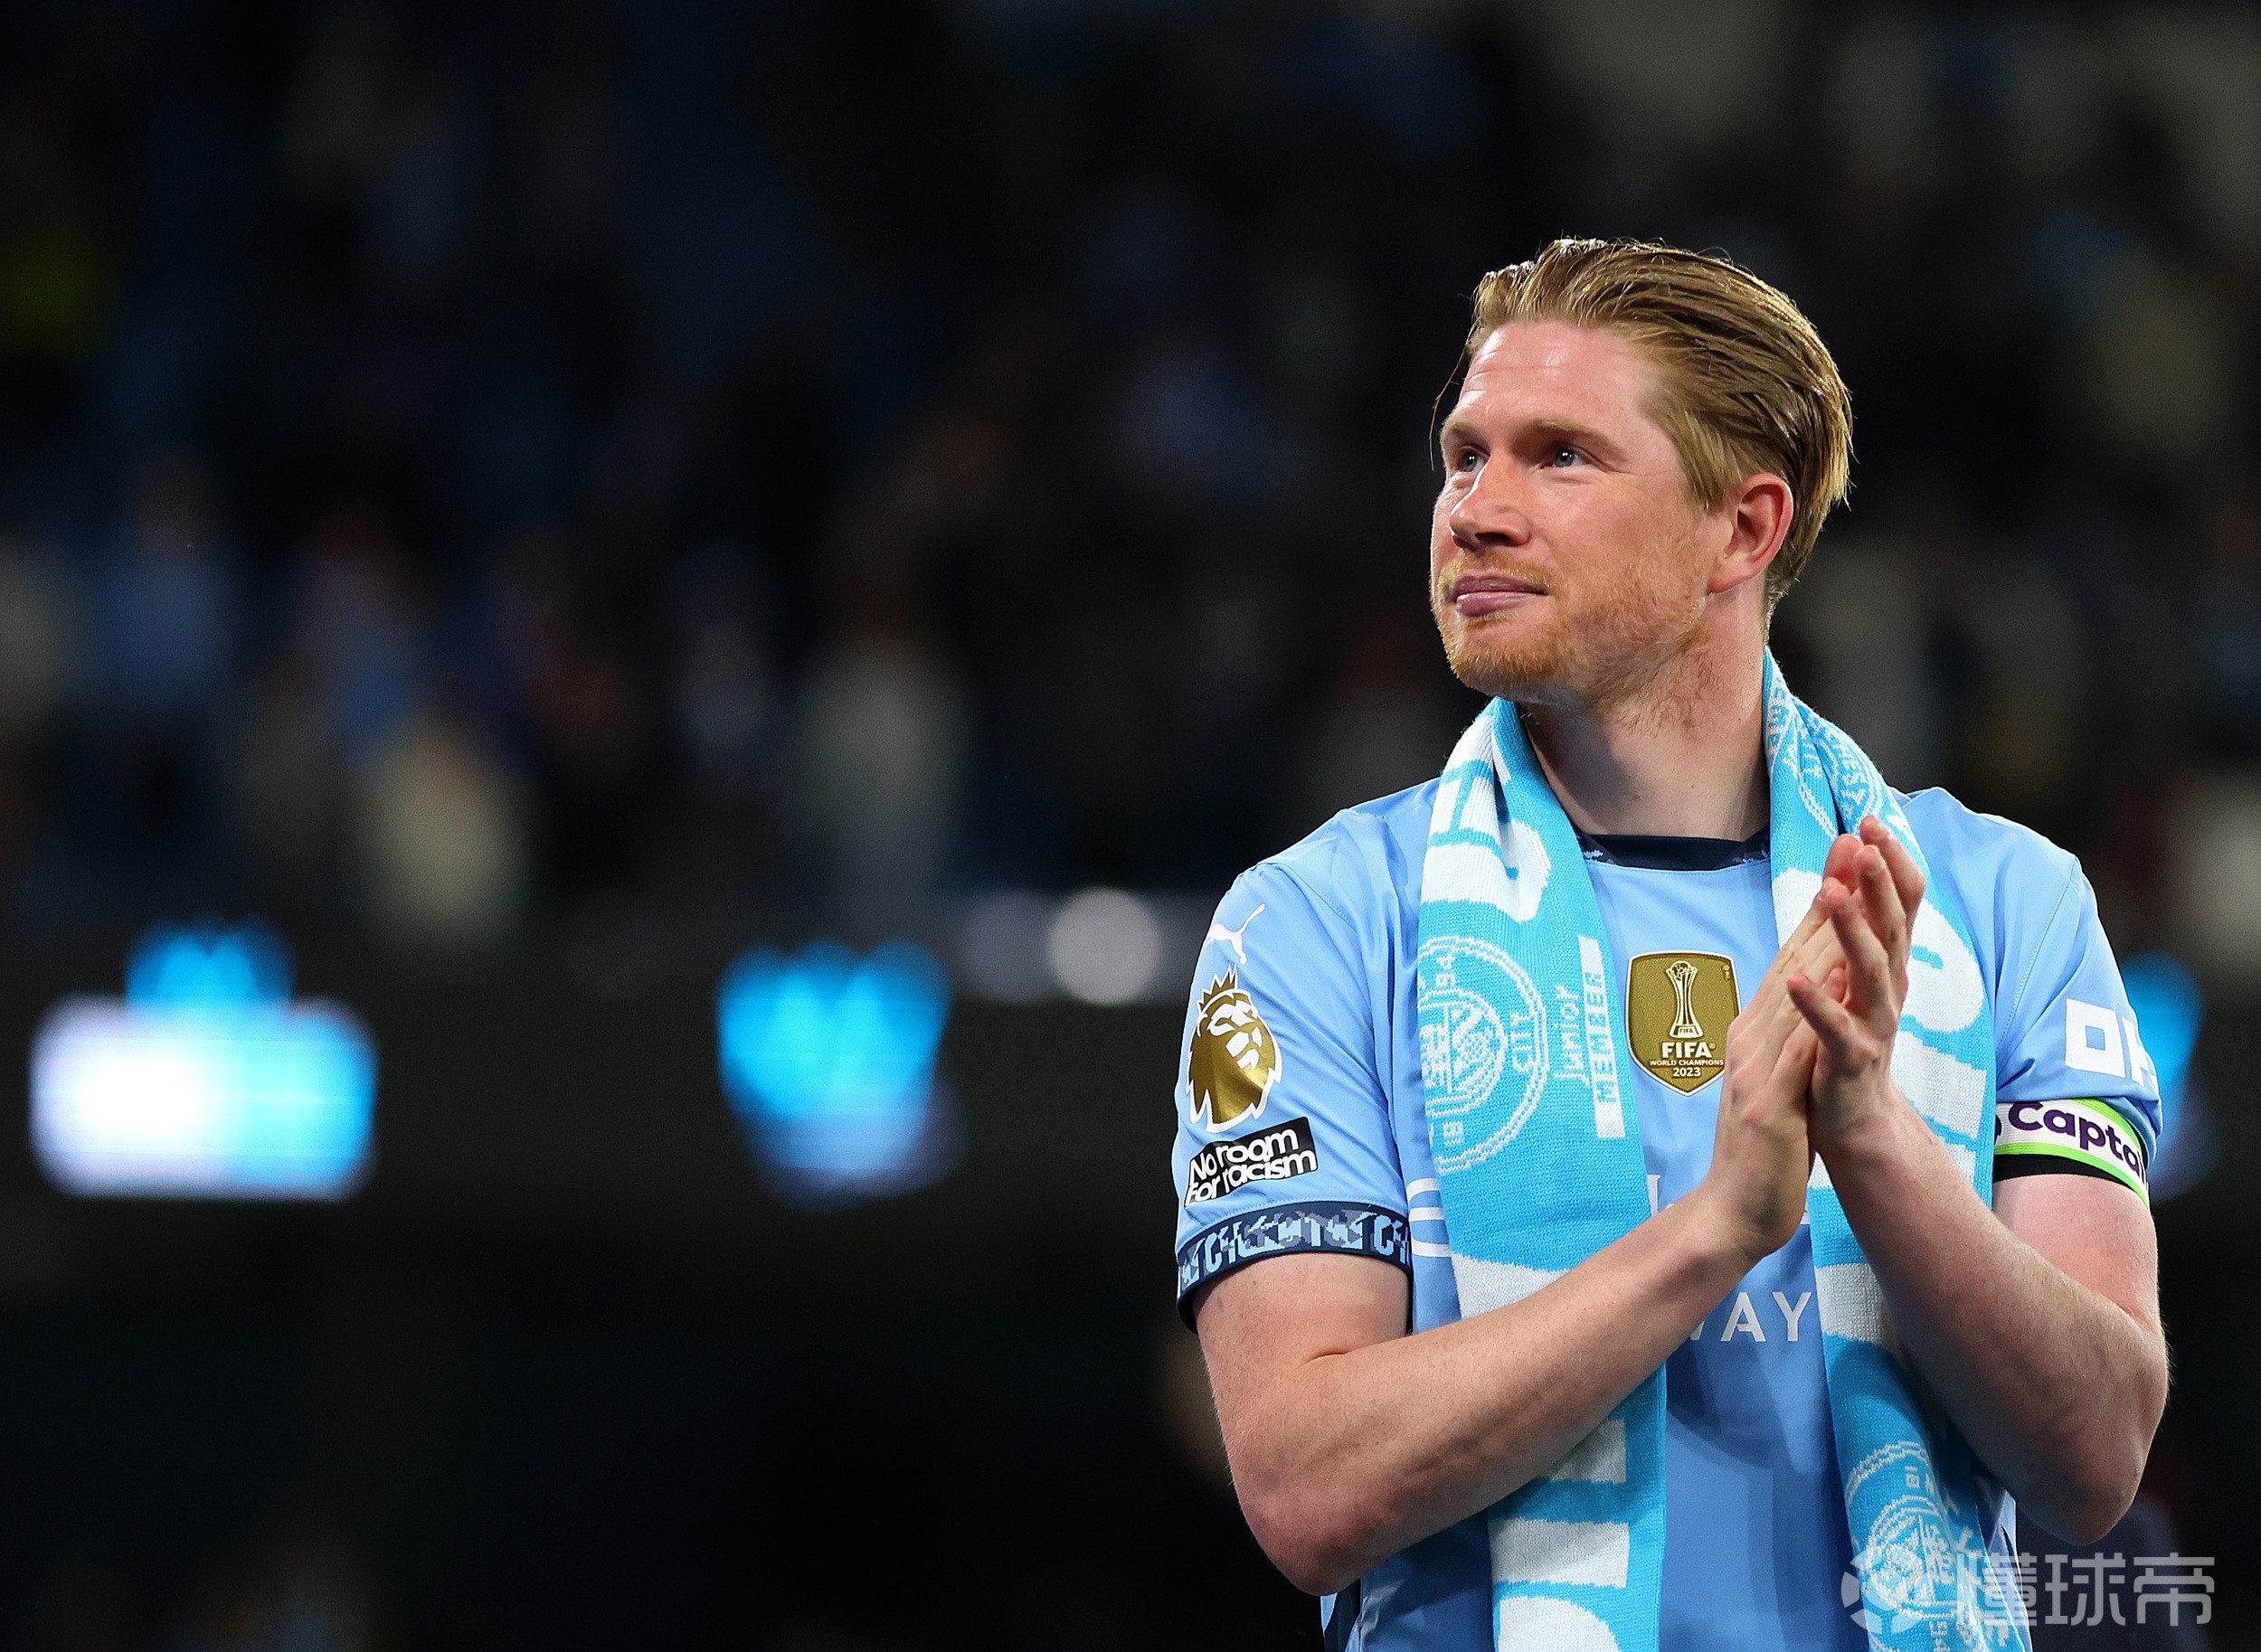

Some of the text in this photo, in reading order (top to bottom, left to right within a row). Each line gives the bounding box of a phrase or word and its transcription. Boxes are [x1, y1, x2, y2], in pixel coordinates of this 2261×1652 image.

[1509, 1011, 1534, 1073] CITY
[1585, 971, 1617, 1103] MEMBER
[1672, 1067, 1701, 1077] 2023
[1186, 1149, 1318, 1206] for racism
[1190, 1128, 1300, 1181] No room
[1689, 1291, 1812, 1343] AY
